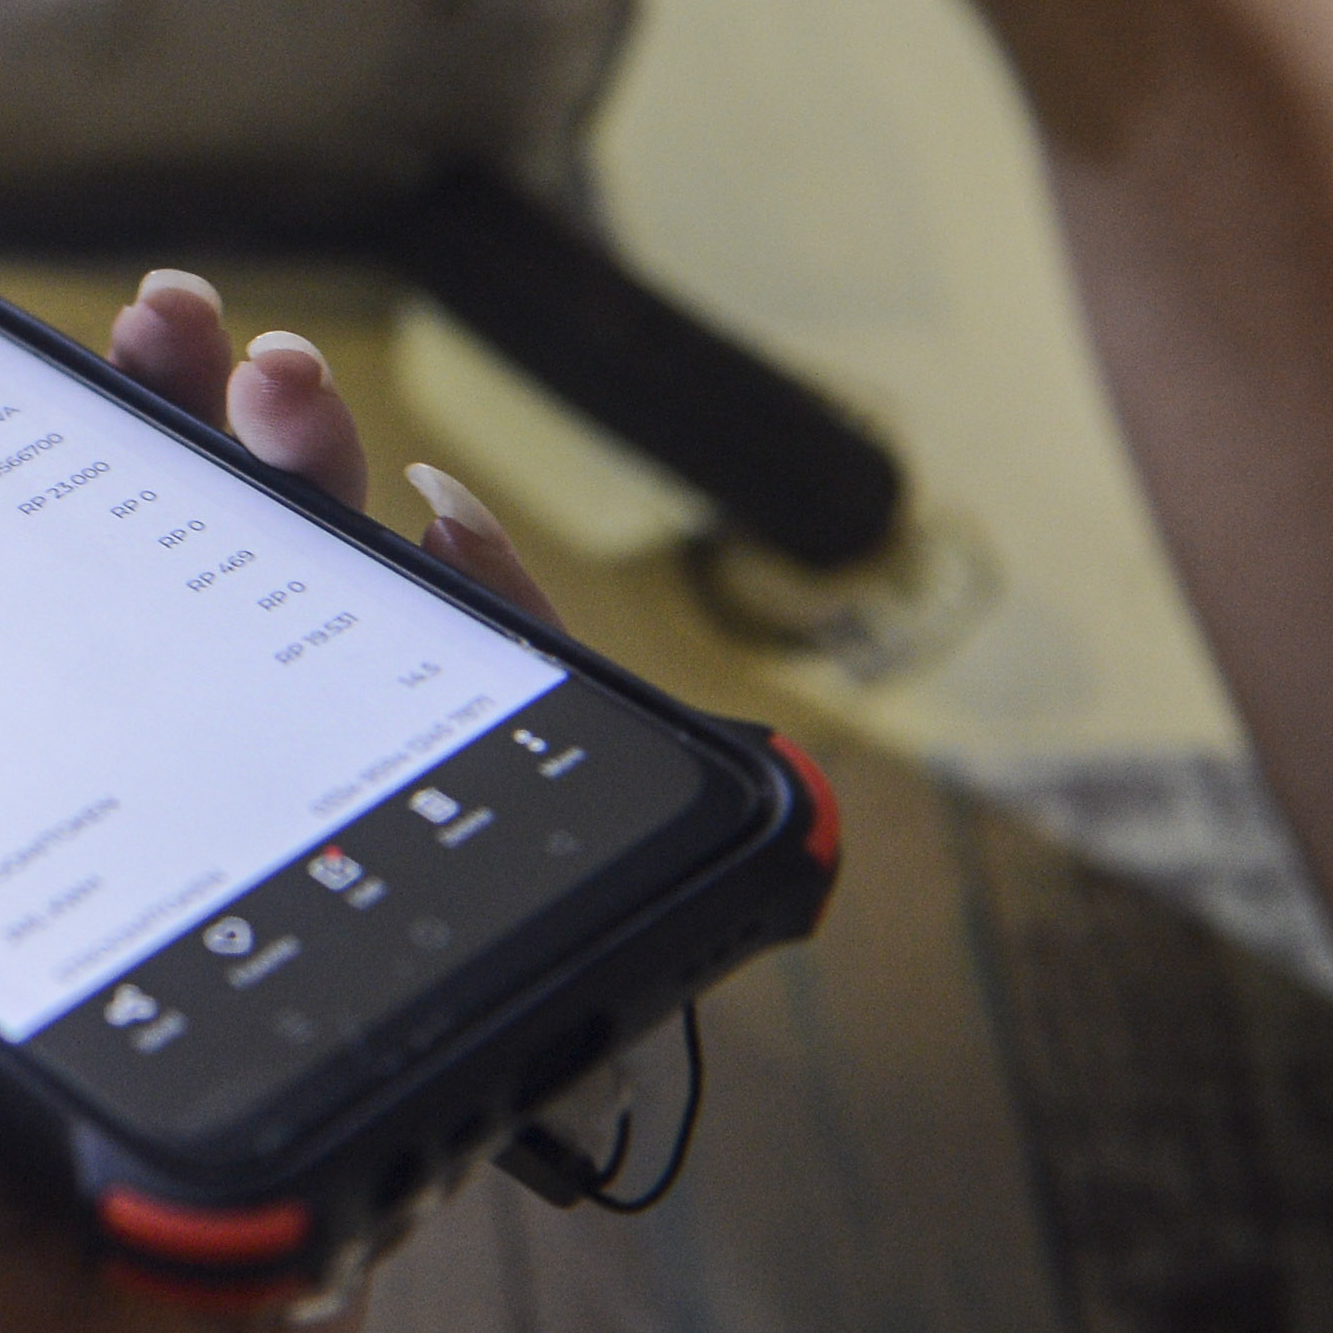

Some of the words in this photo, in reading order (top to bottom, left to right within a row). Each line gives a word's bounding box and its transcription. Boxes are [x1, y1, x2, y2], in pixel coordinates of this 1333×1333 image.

[16, 494, 47, 516] RP
[43, 459, 112, 501] 23.000
[108, 498, 139, 519] RP
[139, 488, 158, 504] 0
[156, 527, 187, 550] RP
[189, 518, 207, 534] 0
[184, 570, 216, 593] RP
[215, 548, 257, 576] 469
[256, 589, 287, 612] RP
[289, 579, 307, 596] 0
[273, 642, 304, 665] RP
